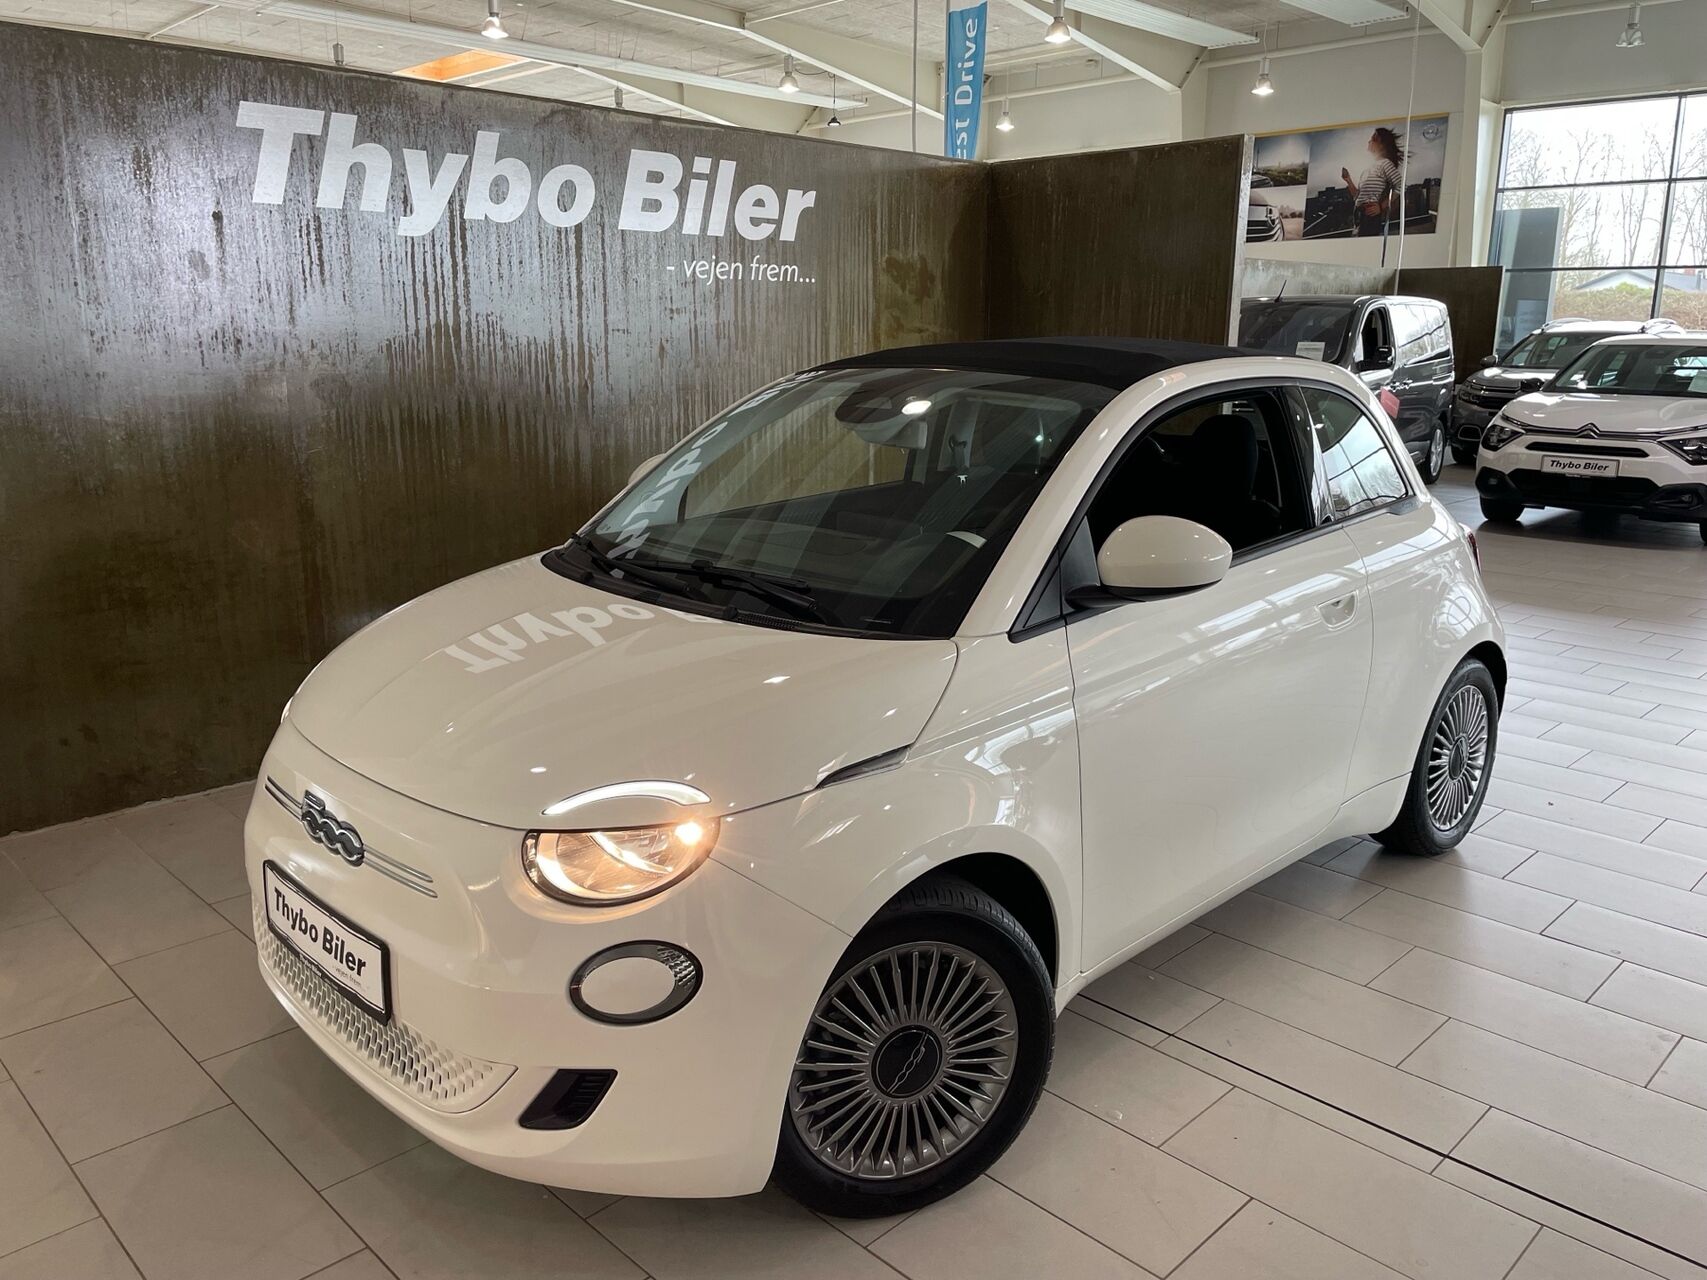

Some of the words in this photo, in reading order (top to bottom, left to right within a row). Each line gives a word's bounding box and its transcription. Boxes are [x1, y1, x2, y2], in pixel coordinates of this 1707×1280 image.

[954, 18, 978, 105] Drive
[236, 100, 596, 237] Thybo
[618, 149, 817, 242] Biler
[955, 118, 970, 160] est
[684, 255, 743, 286] vejen
[749, 254, 816, 284] frem...
[1550, 459, 1582, 470] Thybo
[1583, 462, 1610, 471] Biler
[274, 886, 319, 943] Thybo
[322, 926, 367, 977] Biler
